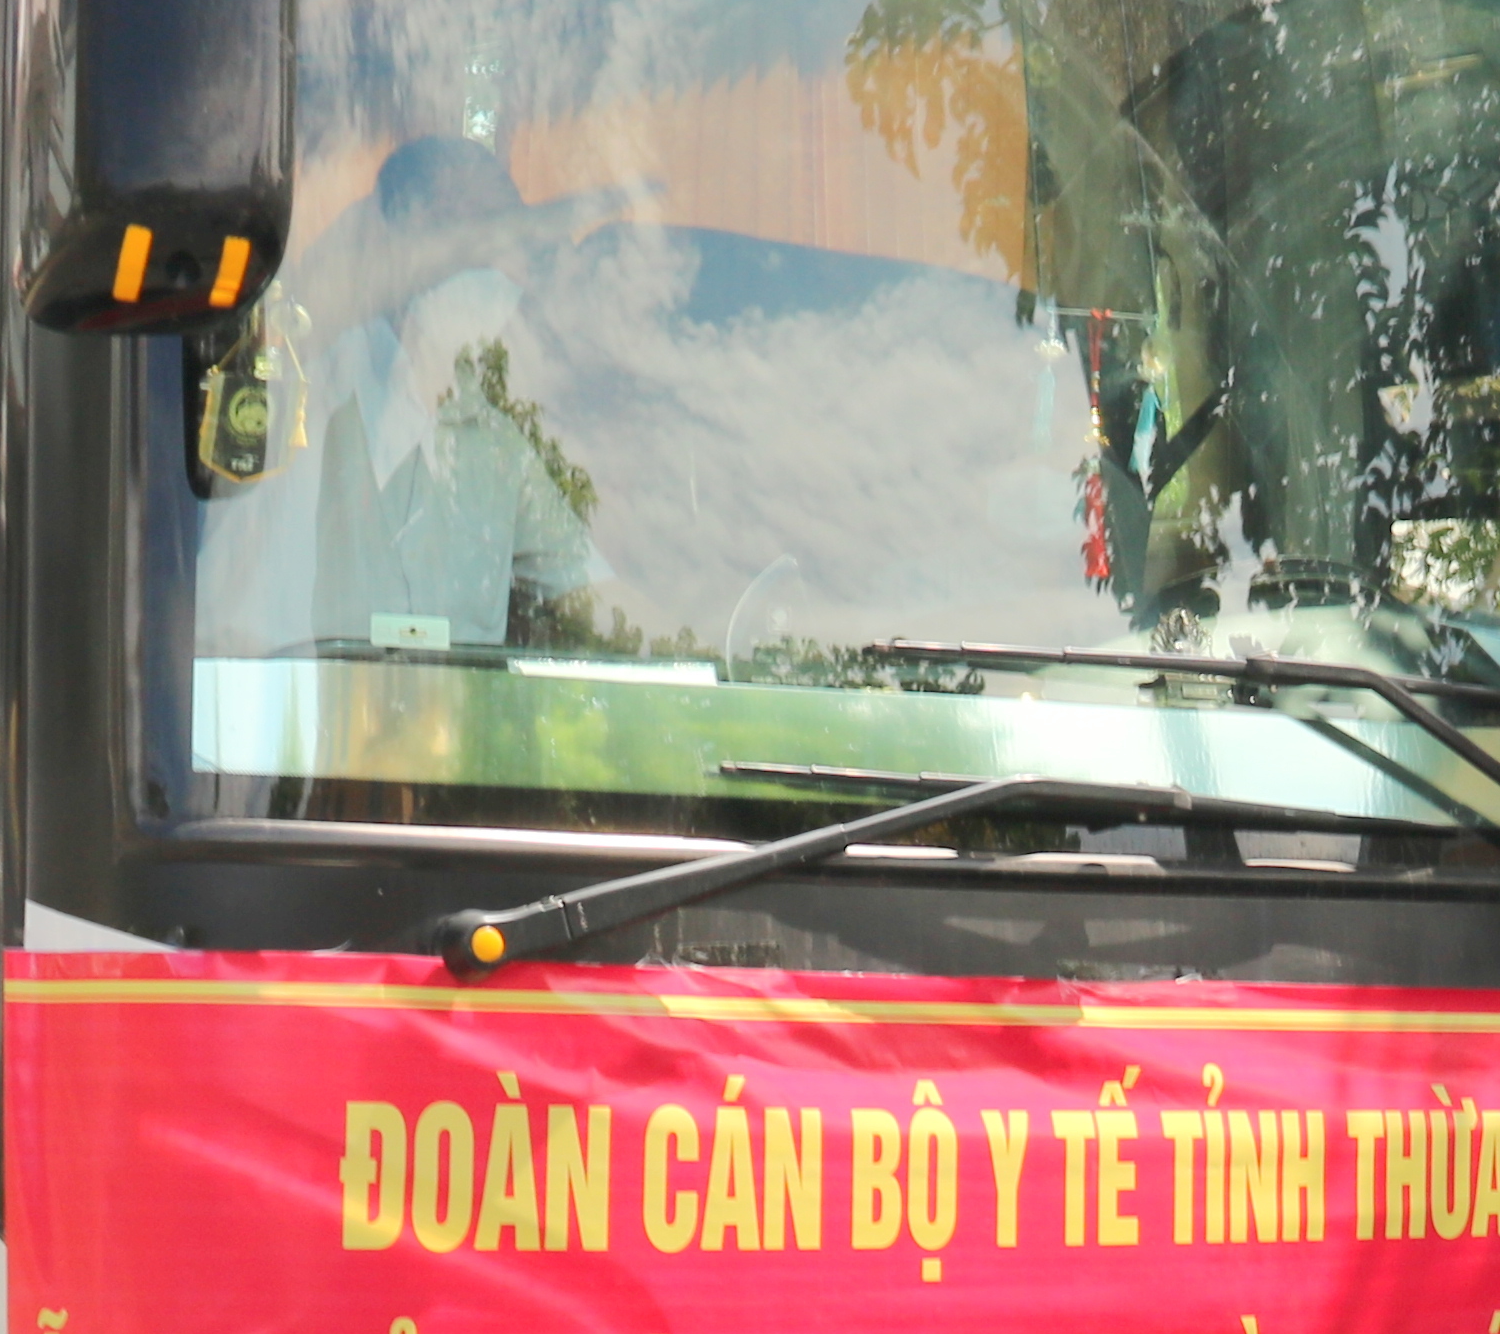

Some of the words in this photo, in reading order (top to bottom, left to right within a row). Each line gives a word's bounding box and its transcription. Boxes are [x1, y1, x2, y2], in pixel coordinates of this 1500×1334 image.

[340, 1071, 611, 1253] ĐOÀN
[644, 1074, 823, 1252] CÁN
[851, 1079, 959, 1282] BỘ
[981, 1109, 1030, 1247] Y
[1050, 1066, 1141, 1246] TẾ
[1160, 1063, 1326, 1244] TỈNH
